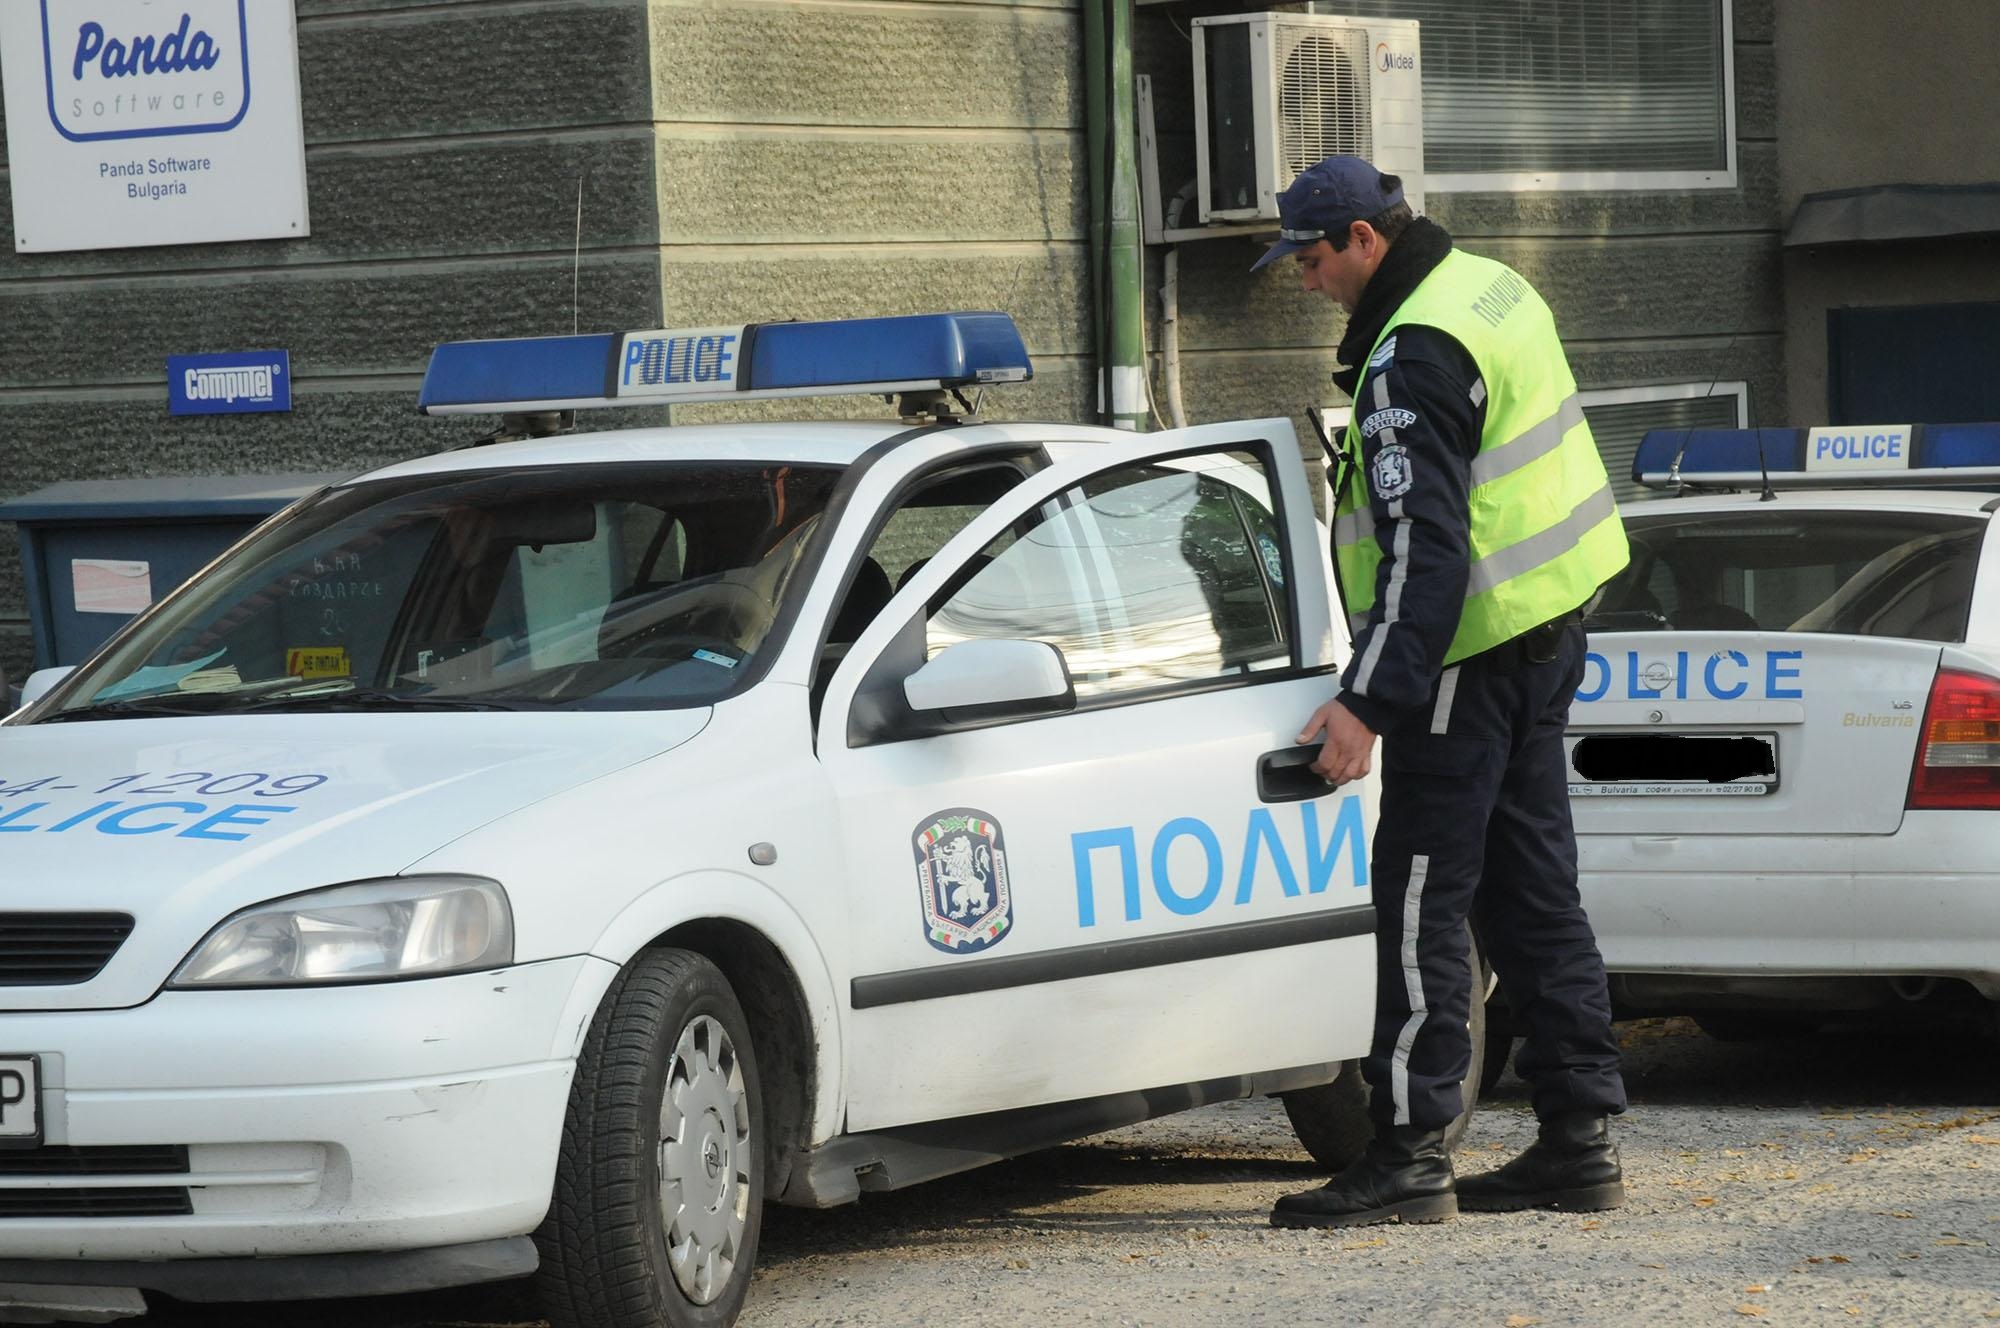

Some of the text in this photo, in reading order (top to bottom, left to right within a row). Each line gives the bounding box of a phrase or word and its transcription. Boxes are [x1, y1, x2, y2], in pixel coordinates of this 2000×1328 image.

[73, 13, 220, 80] Panda
[1377, 46, 1414, 71] Midea
[72, 90, 225, 117] Software
[99, 156, 211, 177] Panda Software
[127, 180, 187, 200] Bulgaria
[1470, 268, 1529, 328] ПОЛИЦИЯ
[623, 335, 736, 385] POLICE
[1816, 434, 1902, 459] POLICE
[1574, 650, 1804, 702] OLICE
[1843, 712, 1915, 727] Bulvaria
[0, 772, 329, 798] 4-1209
[1600, 785, 1638, 794] Bulvaria
[0, 801, 298, 841] LICE
[1070, 795, 1368, 928] ПОЛИ
